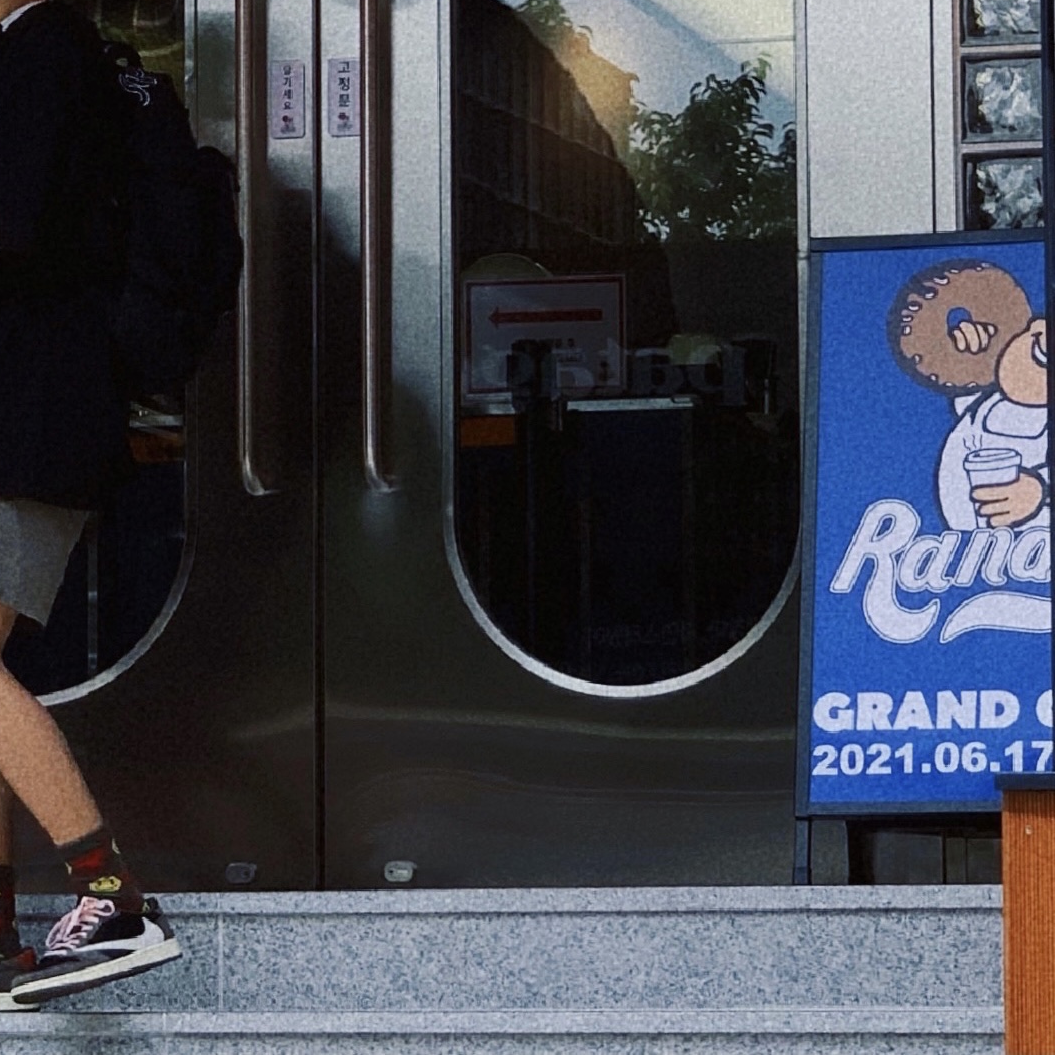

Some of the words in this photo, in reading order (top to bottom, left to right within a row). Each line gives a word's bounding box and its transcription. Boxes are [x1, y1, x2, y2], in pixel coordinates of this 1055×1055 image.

[338, 61, 351, 108] 고정문
[812, 689, 1020, 732] GRAND
[811, 740, 1053, 776] 2021.06.17
